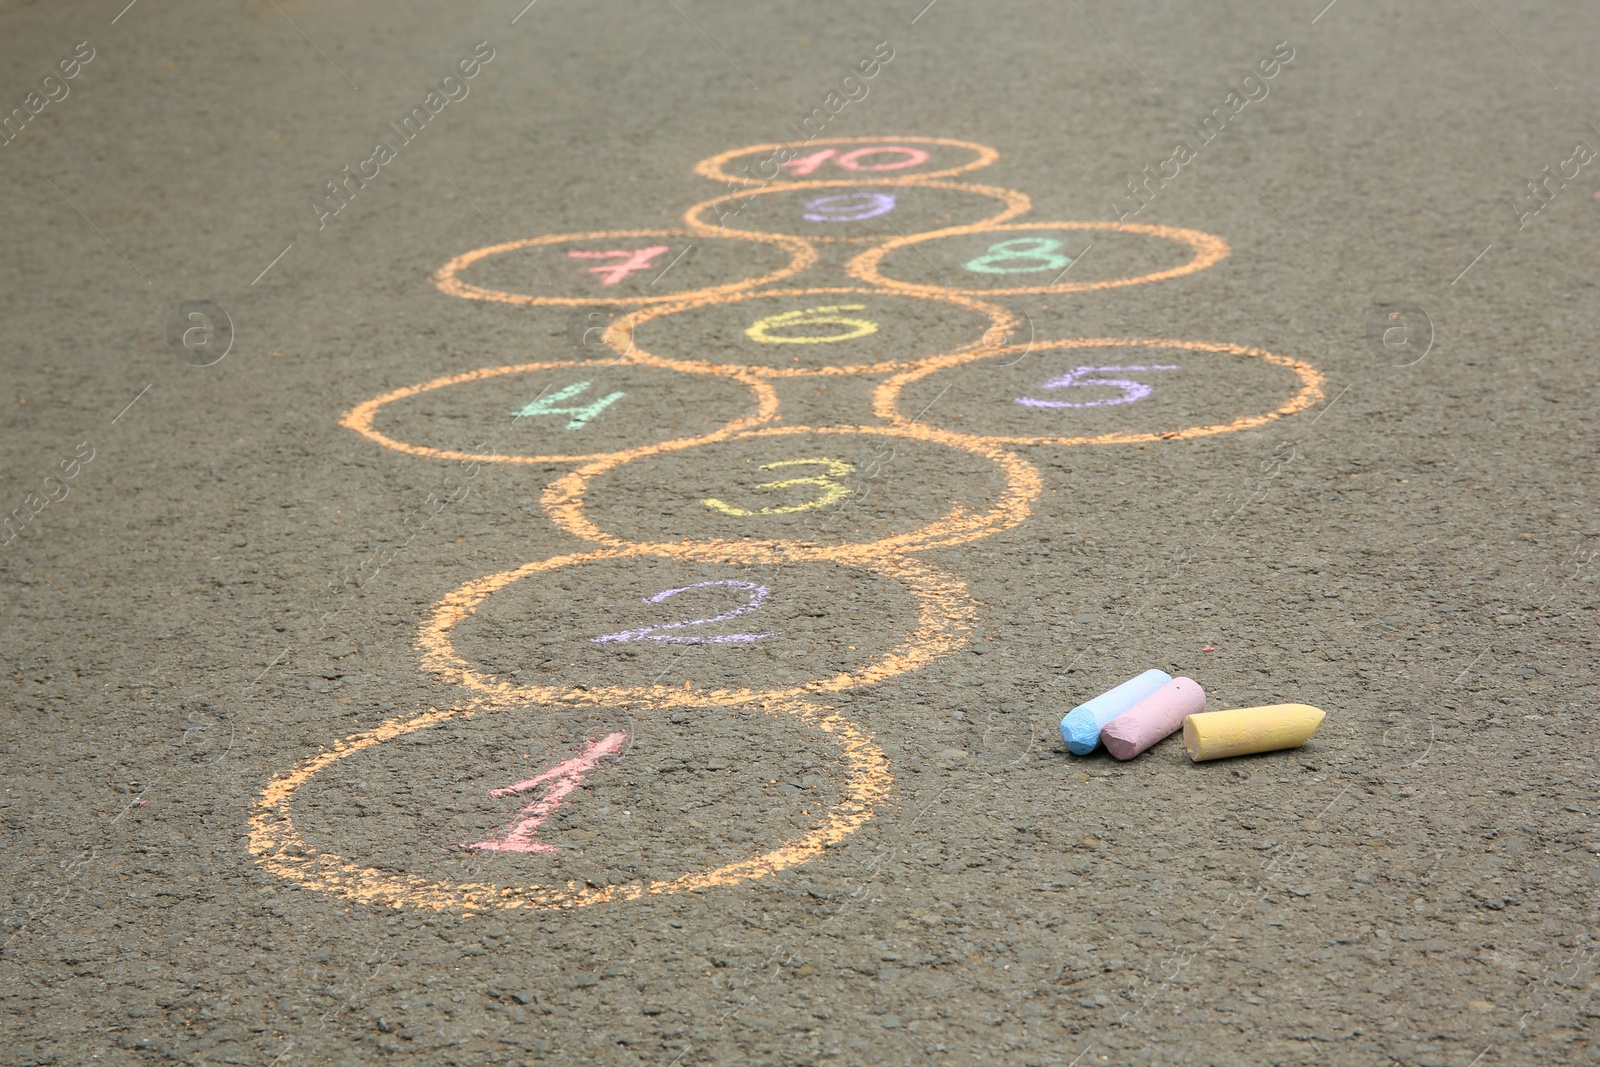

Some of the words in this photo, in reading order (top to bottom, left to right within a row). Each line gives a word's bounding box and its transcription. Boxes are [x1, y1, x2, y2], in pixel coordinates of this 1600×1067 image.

[782, 147, 930, 176] 10
[566, 244, 671, 287] 7
[963, 236, 1072, 276] 8
[744, 302, 879, 345] 6
[510, 380, 626, 431] 4
[1013, 362, 1181, 410] 5
[700, 455, 857, 517] 3
[590, 579, 781, 647] 2
[462, 730, 629, 855] 1
